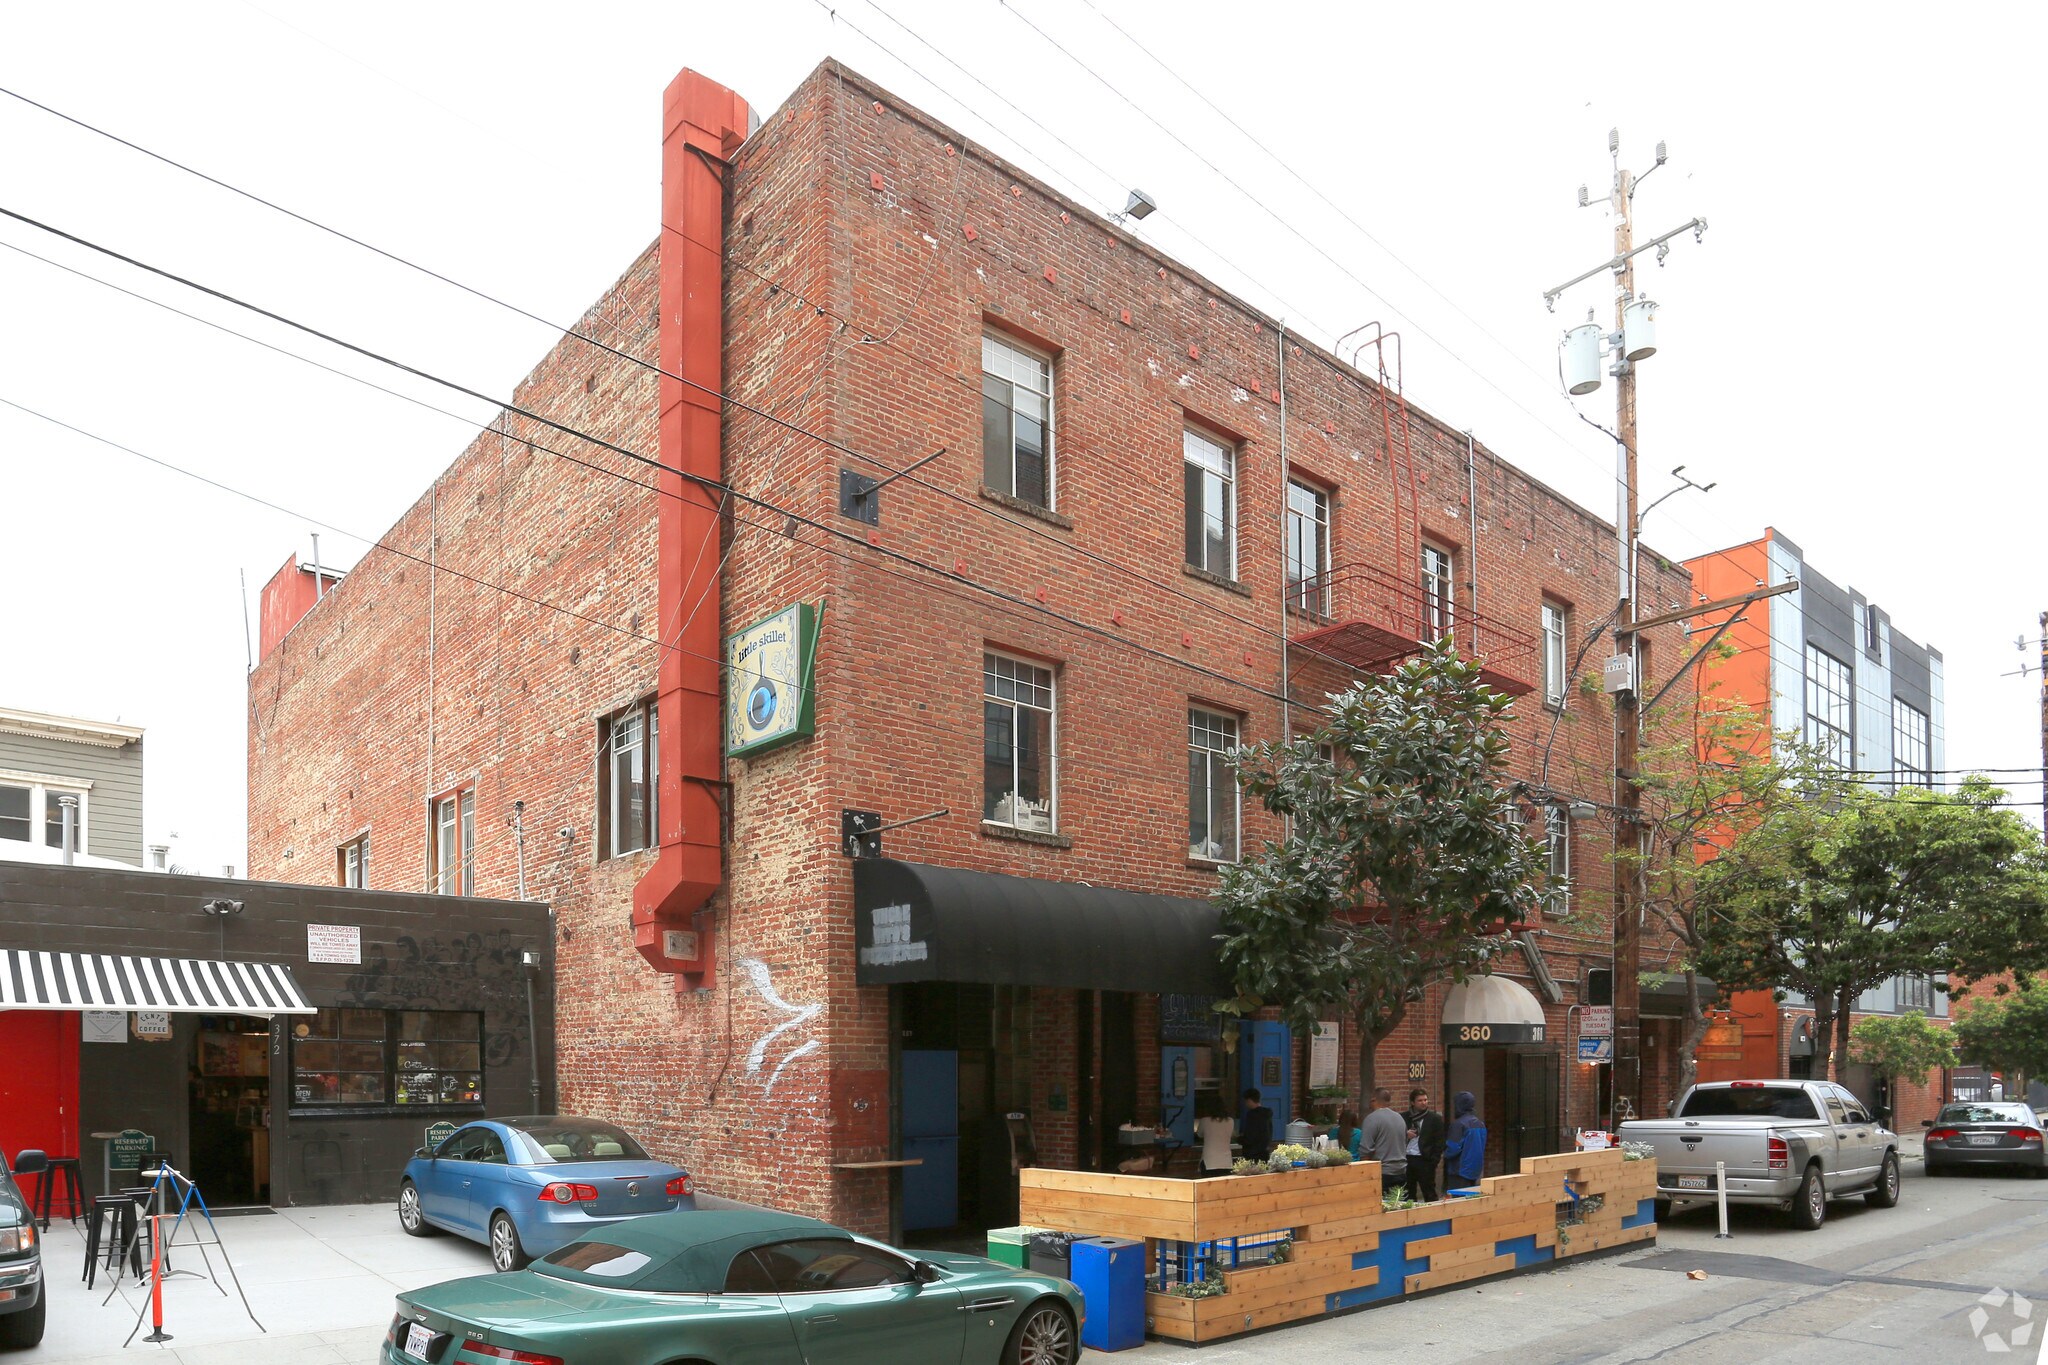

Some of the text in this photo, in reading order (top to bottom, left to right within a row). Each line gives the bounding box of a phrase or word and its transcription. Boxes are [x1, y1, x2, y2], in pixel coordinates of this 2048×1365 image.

[738, 630, 786, 664] little skillet
[140, 1013, 165, 1022] CENTO
[1581, 1007, 1590, 1015] NO
[1460, 1025, 1491, 1041] 360
[1409, 1063, 1425, 1078] 360
